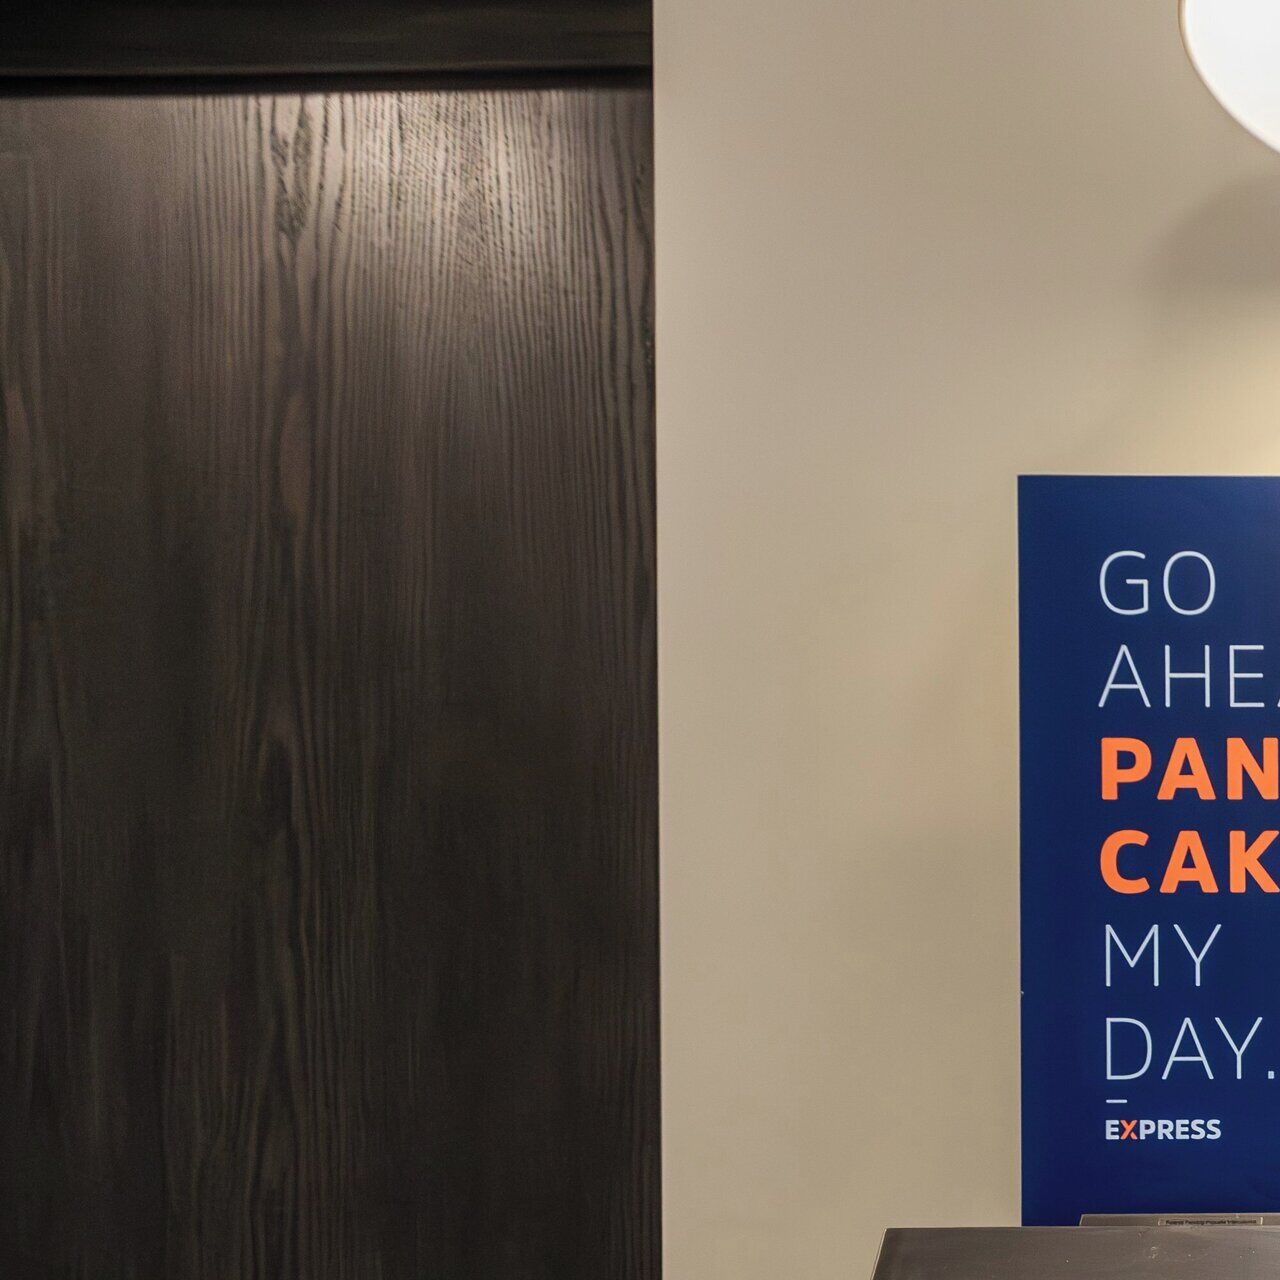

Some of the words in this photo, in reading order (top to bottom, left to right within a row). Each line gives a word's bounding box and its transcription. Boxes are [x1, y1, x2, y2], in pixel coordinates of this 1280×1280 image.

[1099, 550, 1216, 616] GO
[1105, 923, 1222, 987] MY
[1106, 1016, 1275, 1080] DAY.
[1105, 1119, 1222, 1140] EXPRESS
